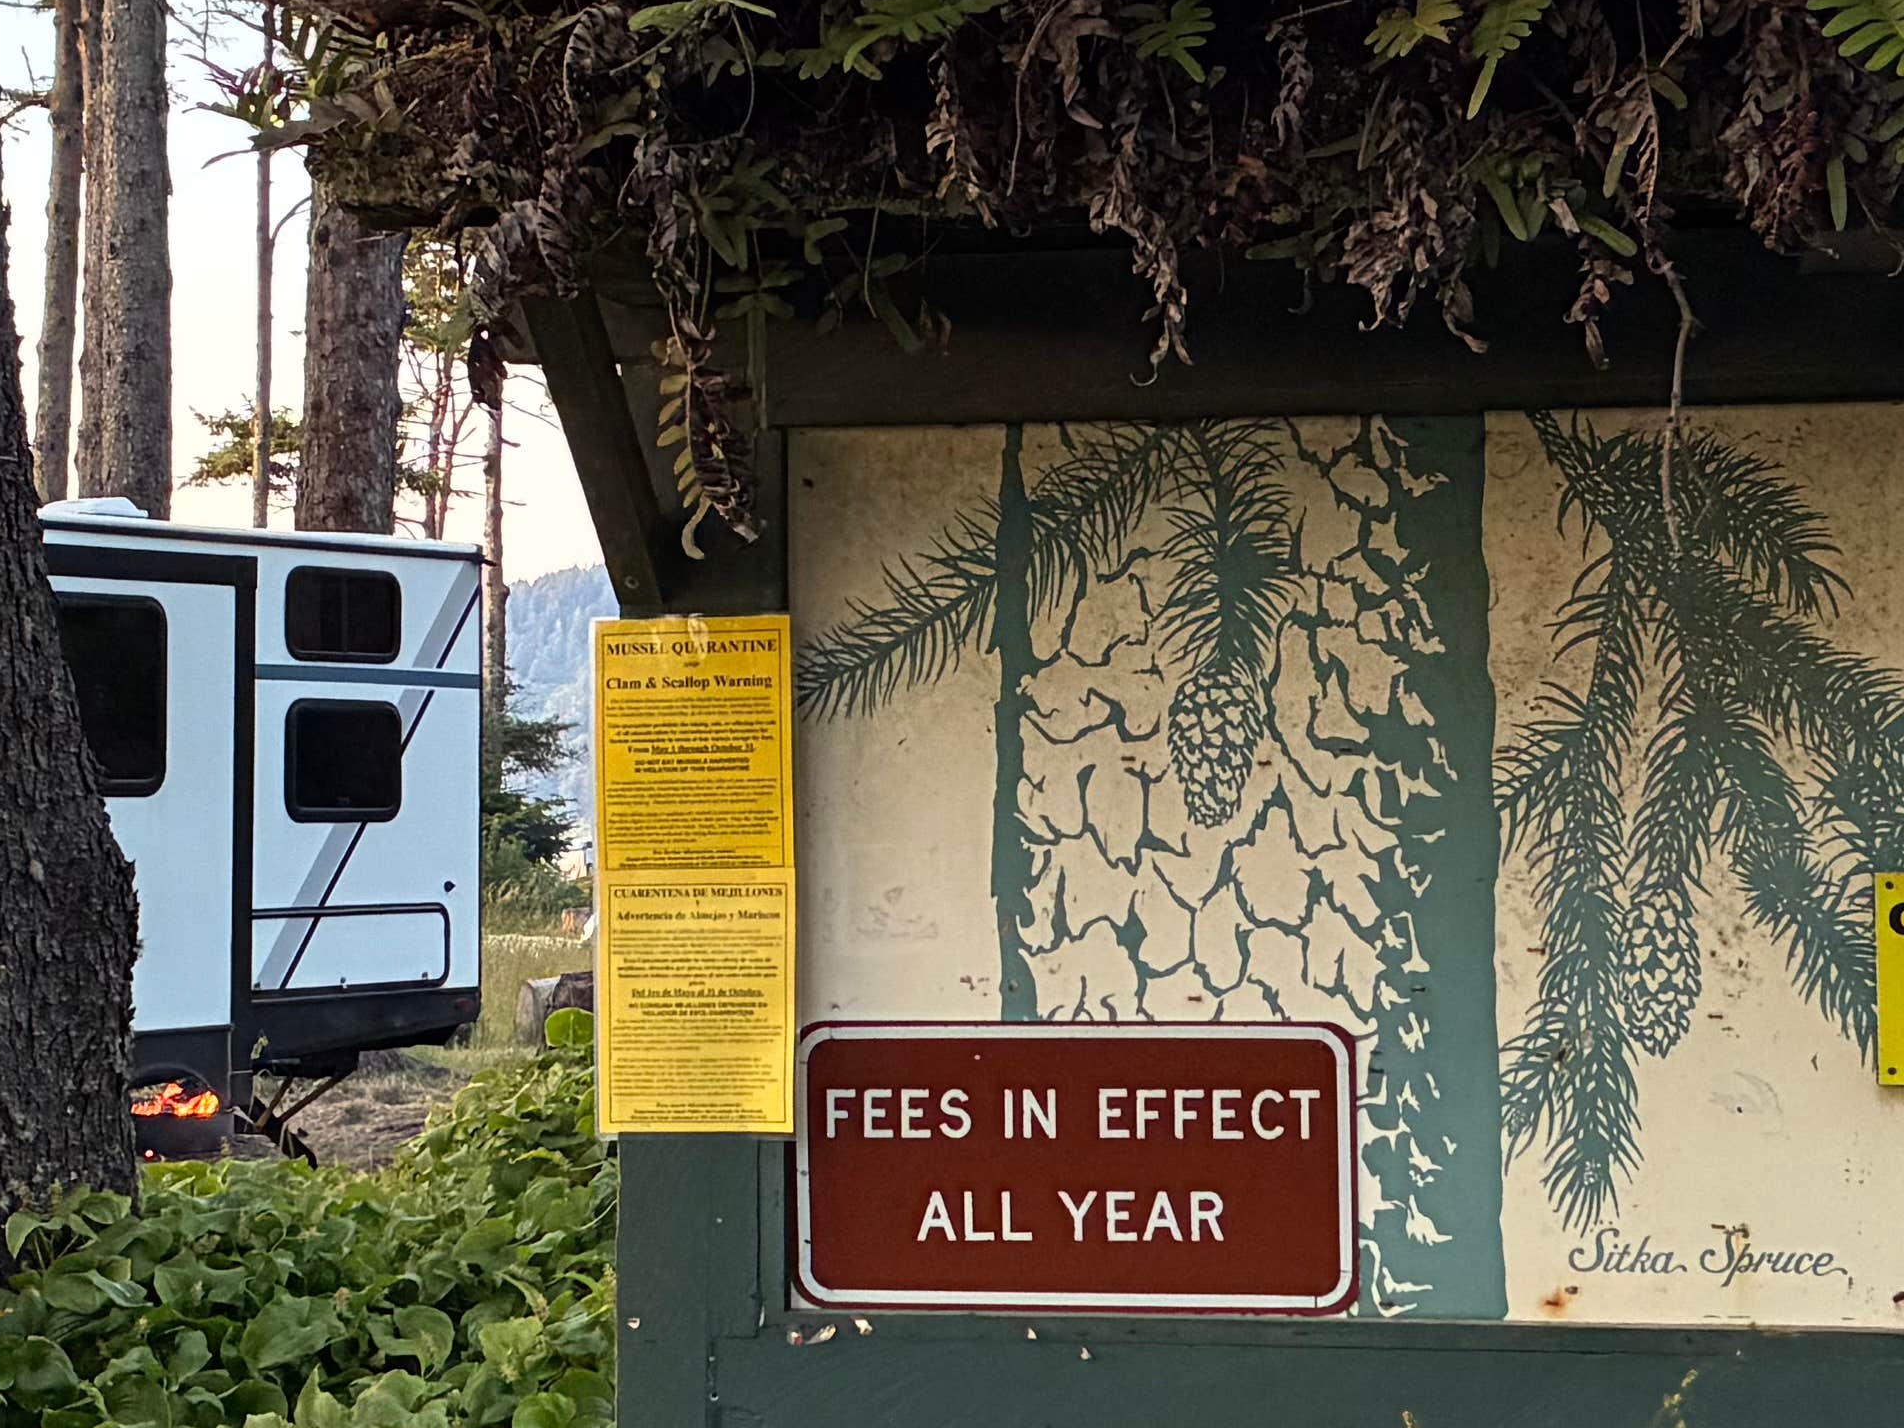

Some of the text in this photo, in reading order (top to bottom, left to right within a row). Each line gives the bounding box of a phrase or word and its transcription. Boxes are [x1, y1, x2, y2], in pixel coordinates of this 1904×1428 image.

[607, 641, 668, 656] MUSSEL
[606, 674, 773, 691] Clam & Scallop Warning
[614, 888, 690, 899] CUARENTENA
[693, 888, 707, 898] DE
[826, 1088, 1321, 1140] FEES IN EFFECT
[916, 1190, 1225, 1242] ALL YEAR
[1568, 1227, 1848, 1287] Sitka Spruce
